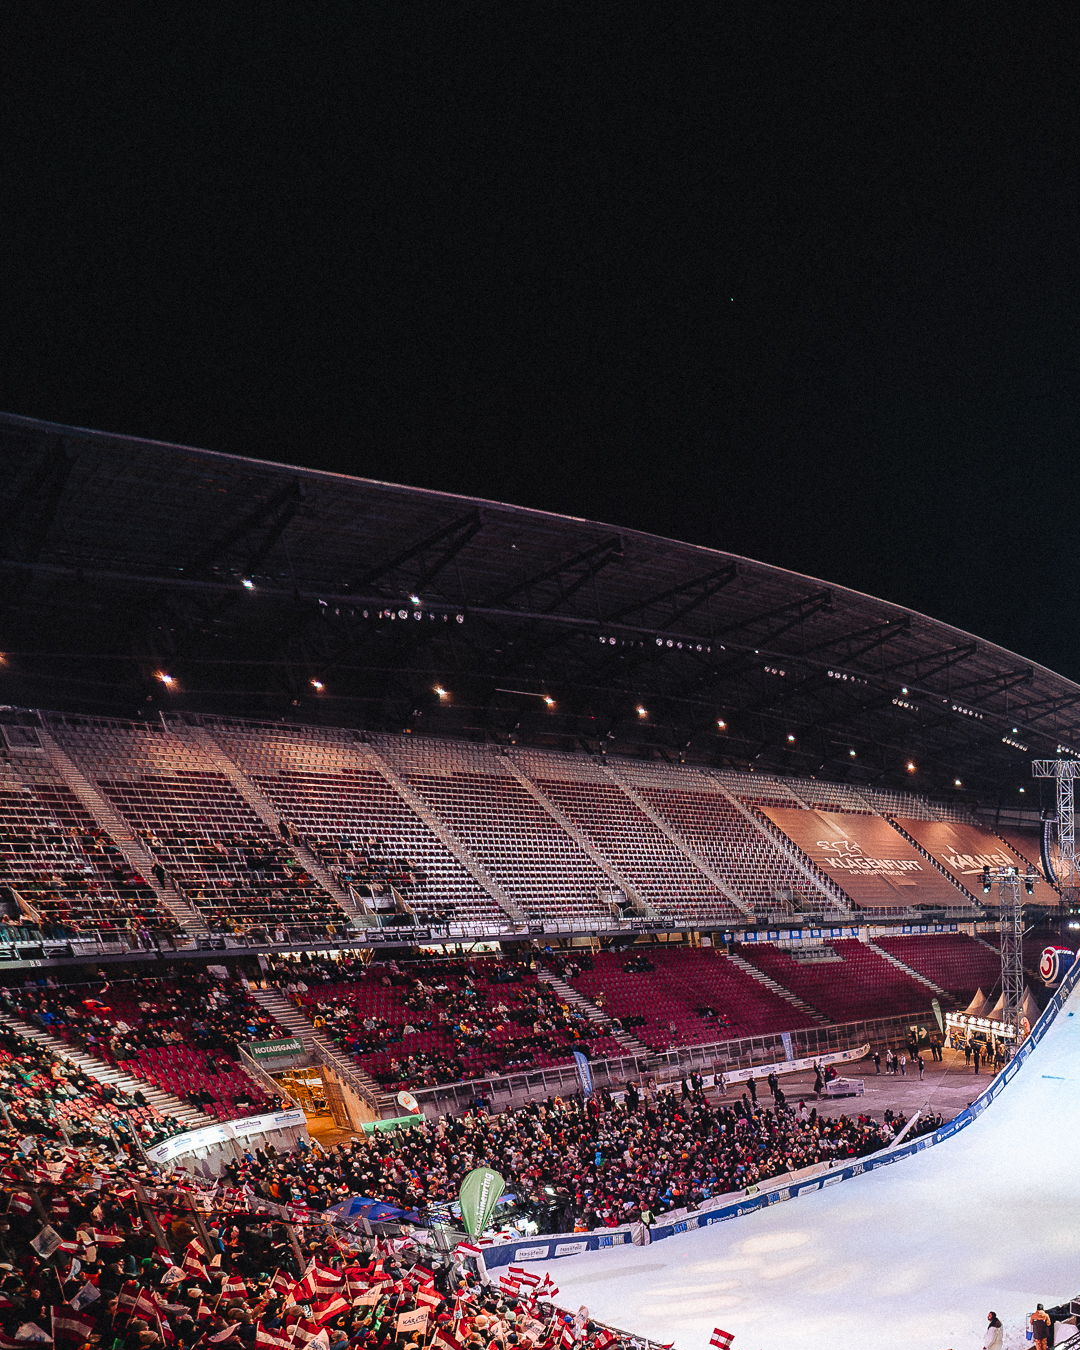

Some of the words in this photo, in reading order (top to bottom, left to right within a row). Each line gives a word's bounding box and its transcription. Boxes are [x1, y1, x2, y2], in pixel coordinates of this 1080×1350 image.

[824, 857, 924, 871] KLAGENFURT
[254, 1042, 302, 1055] NOTAUSGANG
[519, 1249, 544, 1258] Nassfeld
